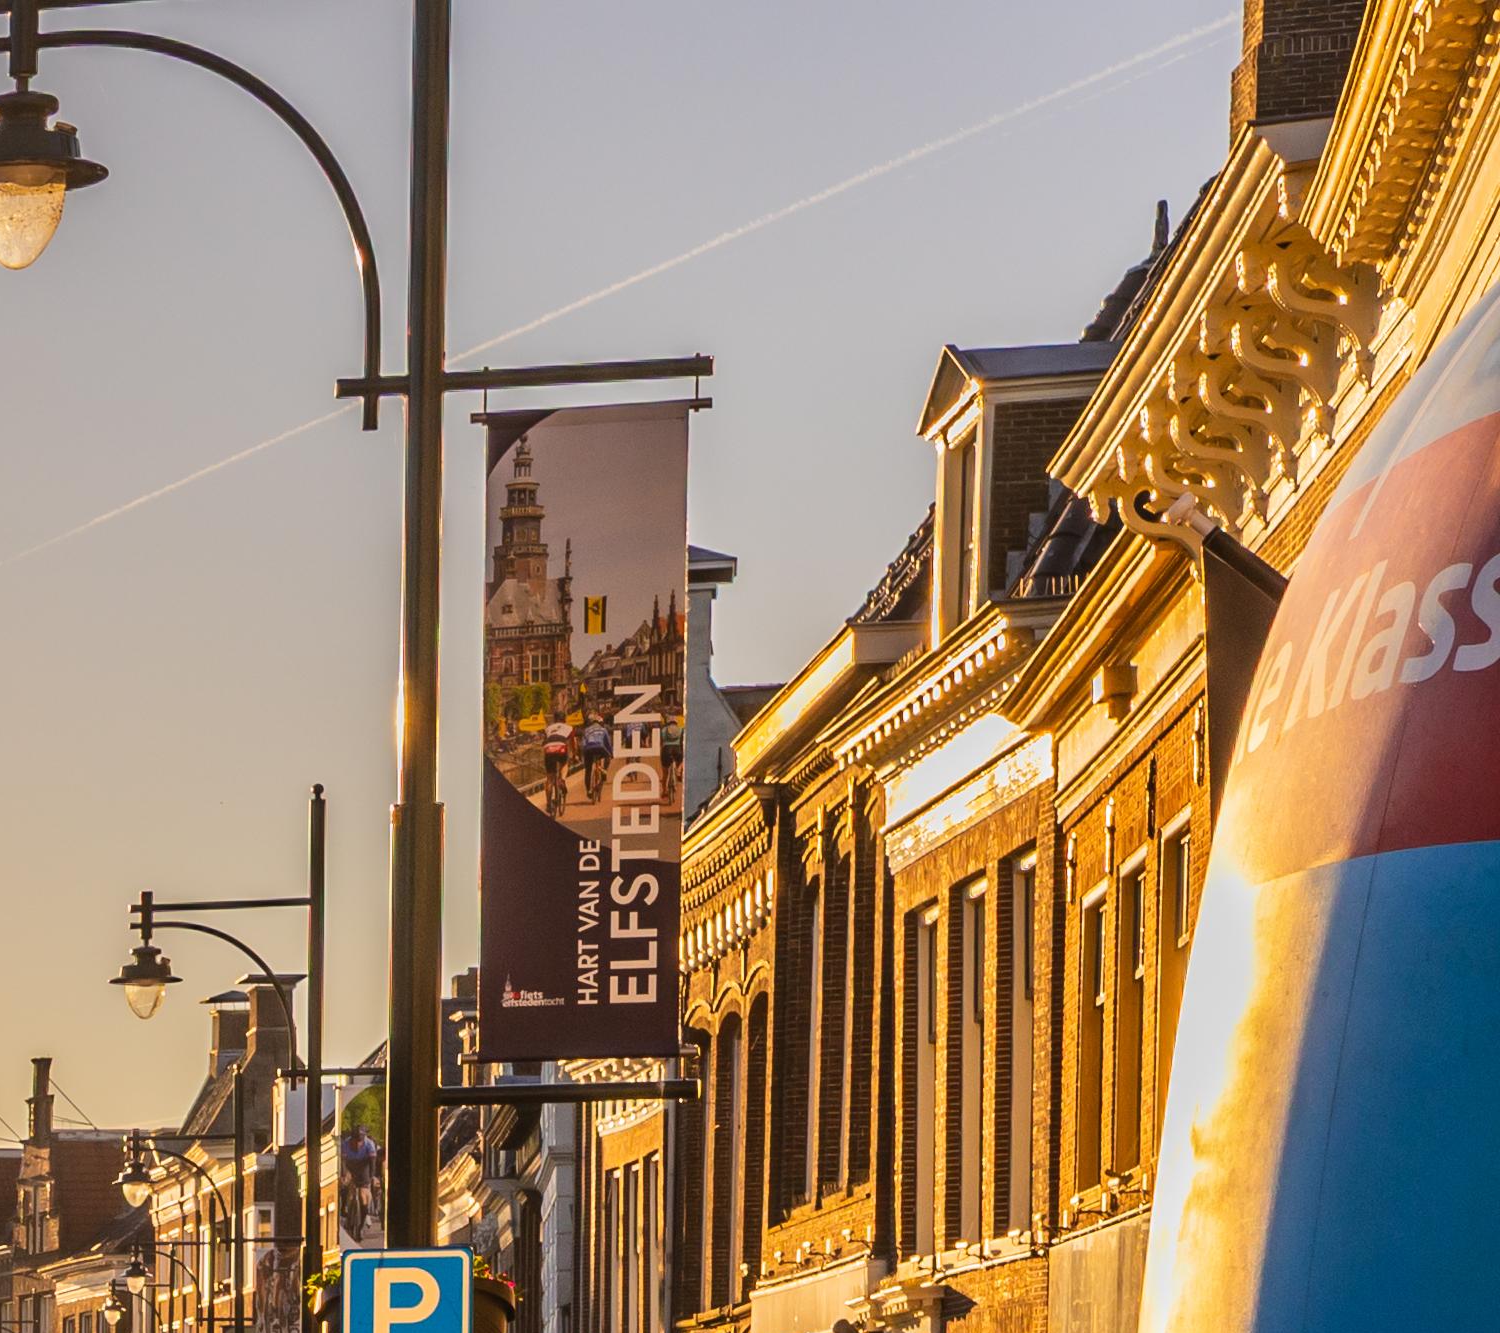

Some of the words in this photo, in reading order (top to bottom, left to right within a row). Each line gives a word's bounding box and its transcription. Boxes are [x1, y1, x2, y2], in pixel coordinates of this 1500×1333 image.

[579, 840, 600, 872] DE
[609, 683, 662, 1004] ELFSTEDEN
[578, 881, 599, 933] VAN
[577, 939, 598, 1005] HART
